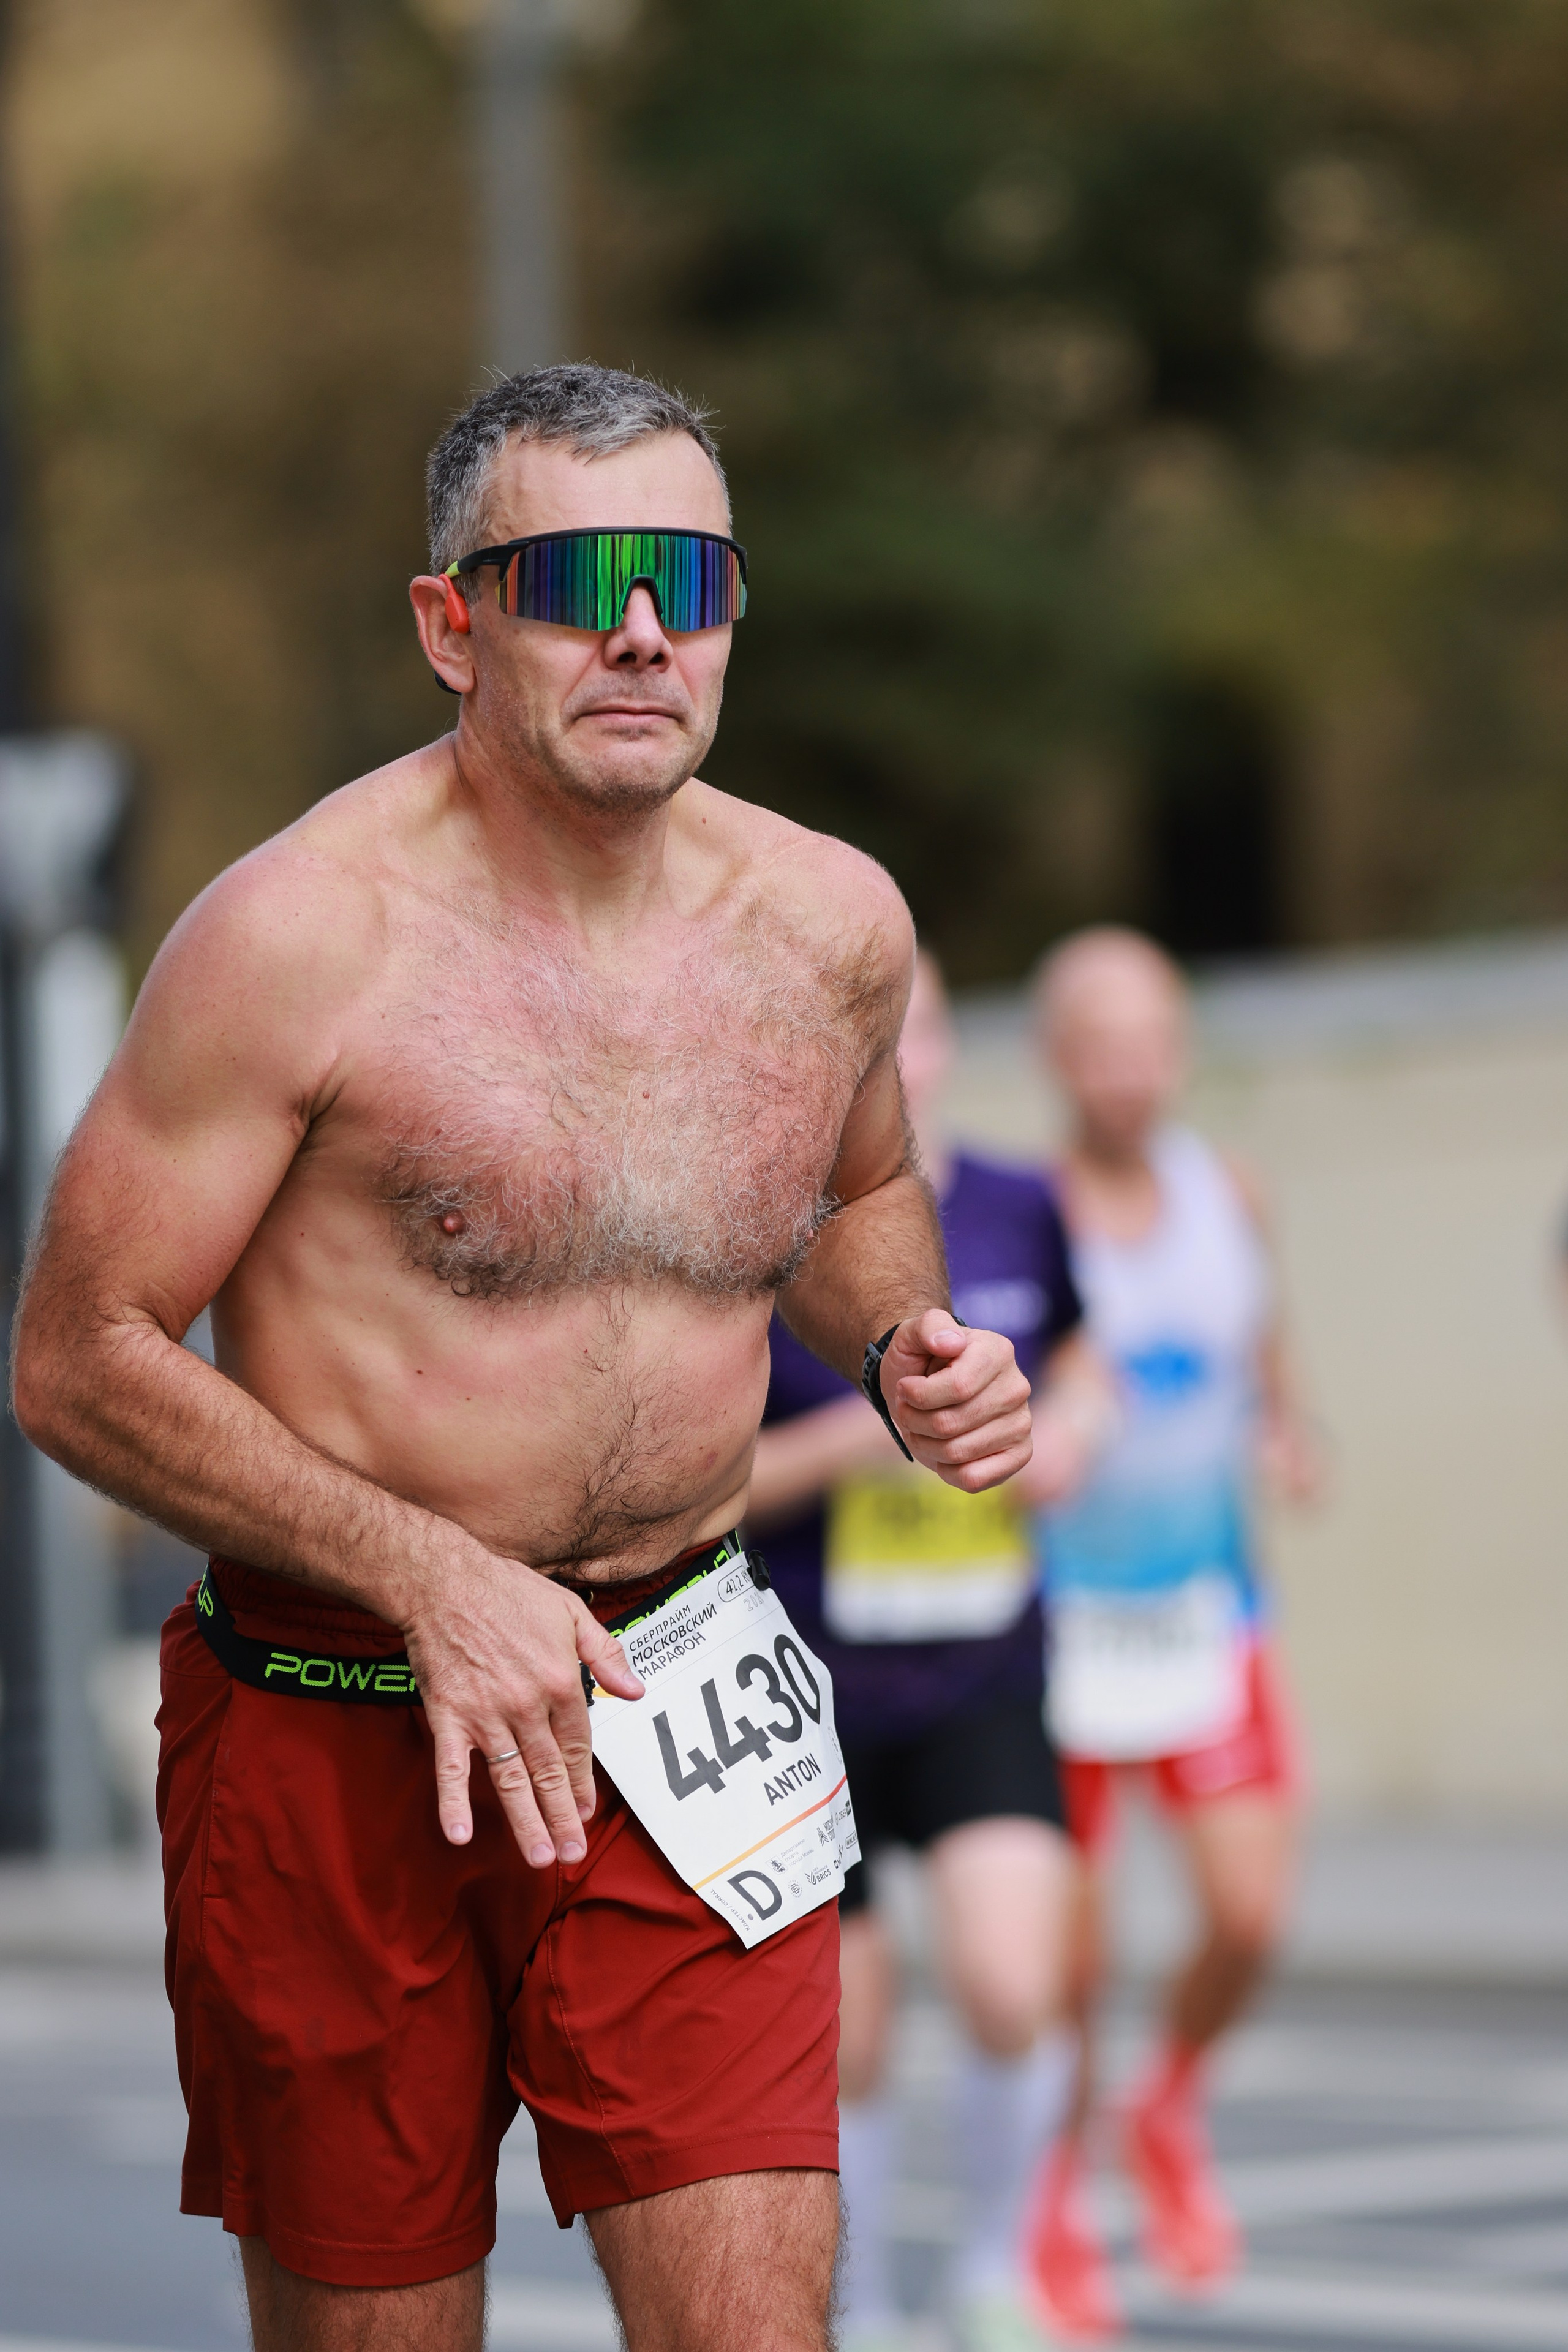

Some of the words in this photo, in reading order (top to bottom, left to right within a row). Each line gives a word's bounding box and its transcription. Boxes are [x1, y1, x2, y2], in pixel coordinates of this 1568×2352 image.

[629, 1604, 692, 1652] СБЕРПРАЙМ
[631, 1602, 717, 1667] МОСКОВСКИЙ
[638, 1632, 707, 1681] МАРАФОН
[652, 1634, 821, 1802] 4430
[763, 1752, 822, 1806] ANTON
[710, 1888, 729, 1906] CORRAL
[727, 1870, 782, 1921] D
[816, 1869, 832, 1882] BRICS
[730, 1908, 750, 1931] КЛАСТЕР
